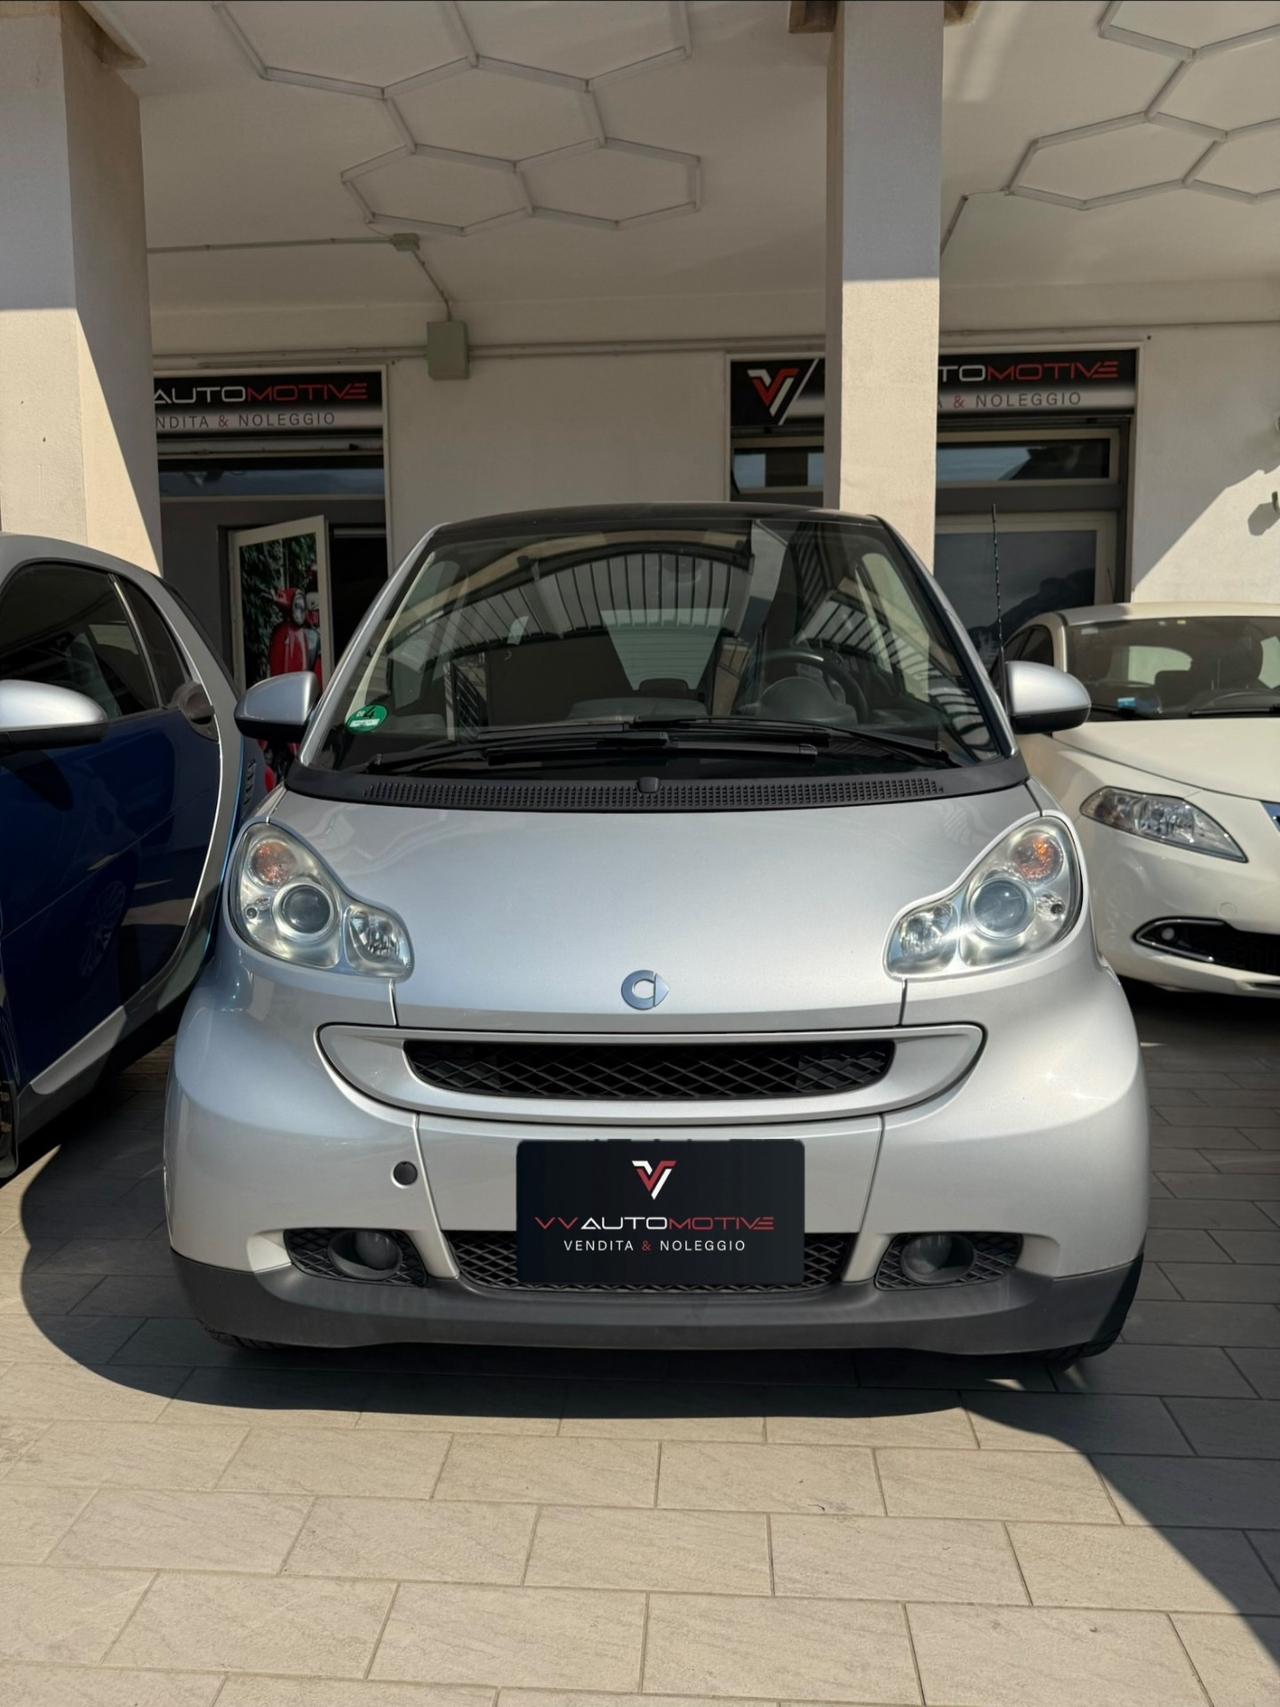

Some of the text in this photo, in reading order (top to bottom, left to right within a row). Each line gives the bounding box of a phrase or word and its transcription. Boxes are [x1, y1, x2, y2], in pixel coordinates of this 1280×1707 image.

[953, 394, 965, 408] &
[975, 391, 1082, 408] NOLEGGIO
[218, 414, 229, 428] &
[239, 411, 336, 427] NOLEGGIO
[534, 1216, 775, 1231] VVAUTOMOTIVE
[563, 1239, 746, 1252] VENDITA & NOLEGGIO
